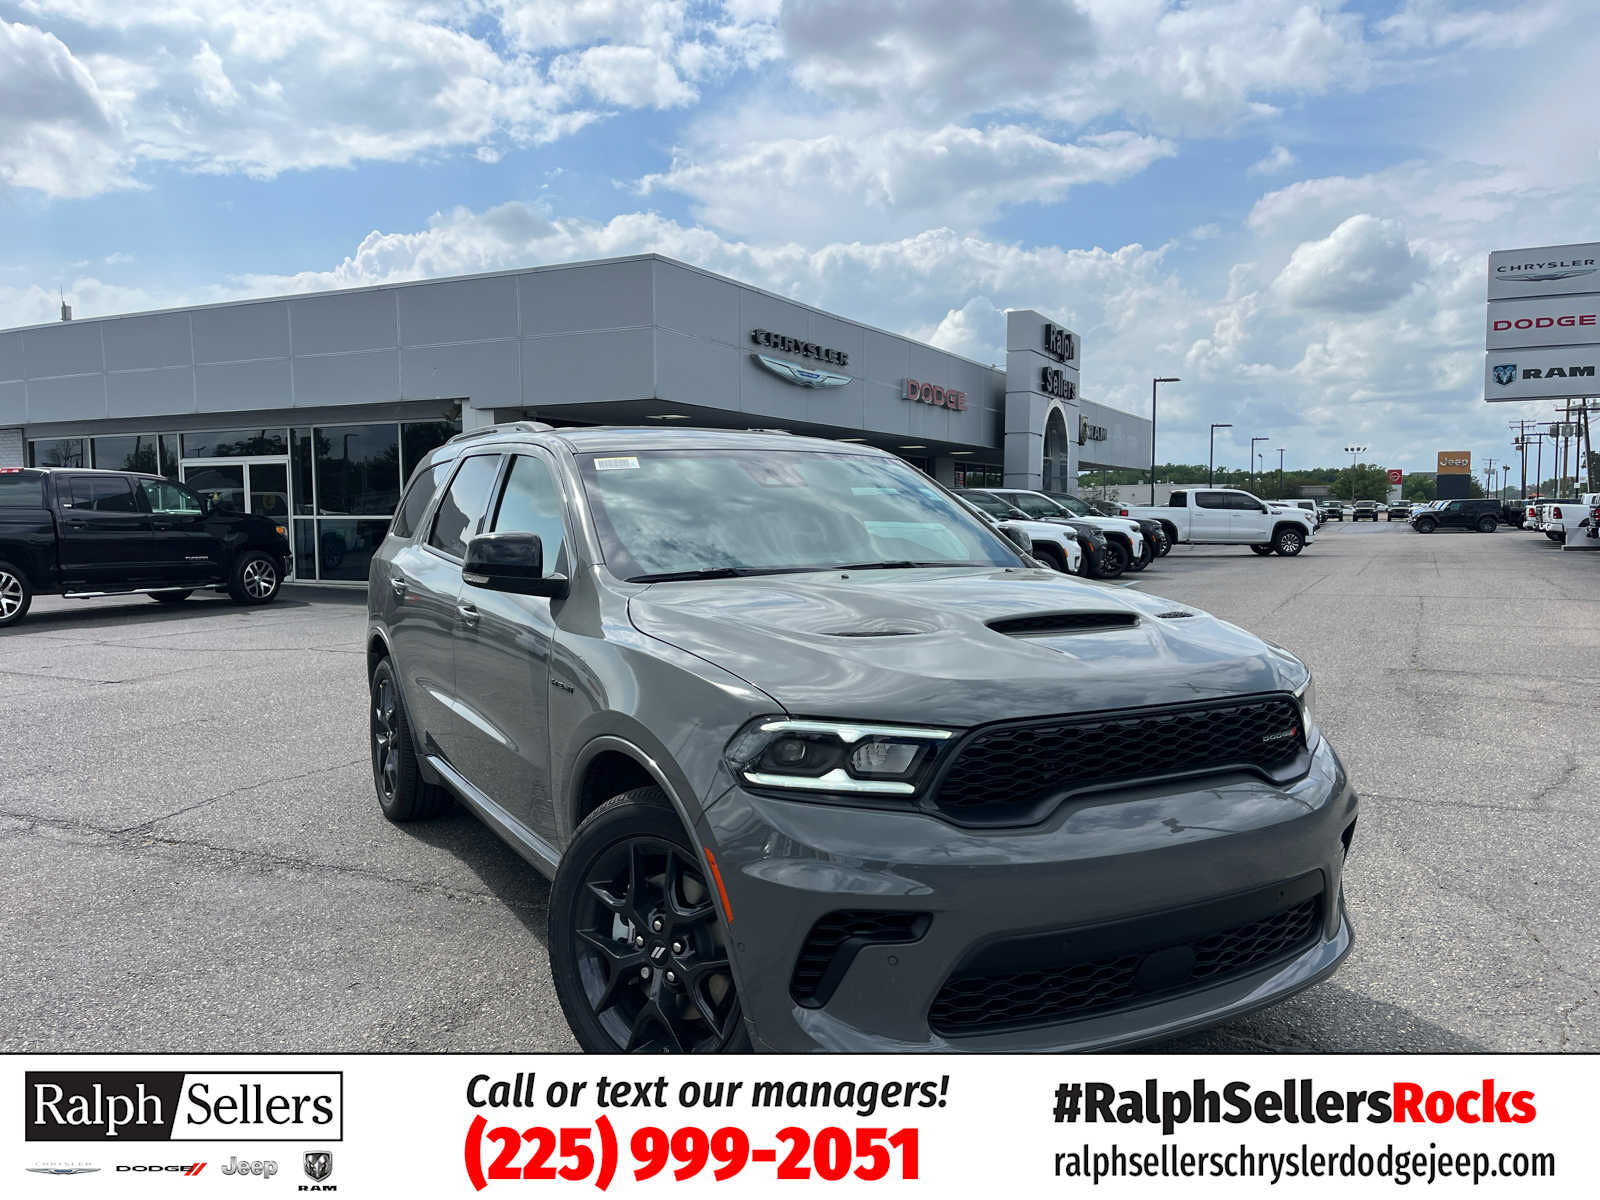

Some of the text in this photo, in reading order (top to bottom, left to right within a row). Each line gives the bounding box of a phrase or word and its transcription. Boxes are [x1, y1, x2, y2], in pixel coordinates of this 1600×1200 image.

[1497, 259, 1596, 273] CHRYSLER
[1493, 314, 1597, 332] DODGE
[751, 328, 849, 367] CHRYSLER
[1045, 323, 1075, 362] Ralph
[1042, 366, 1077, 401] Sellers
[1522, 366, 1596, 380] RAM
[904, 378, 969, 411] DODGE
[1440, 456, 1469, 467] Jeep
